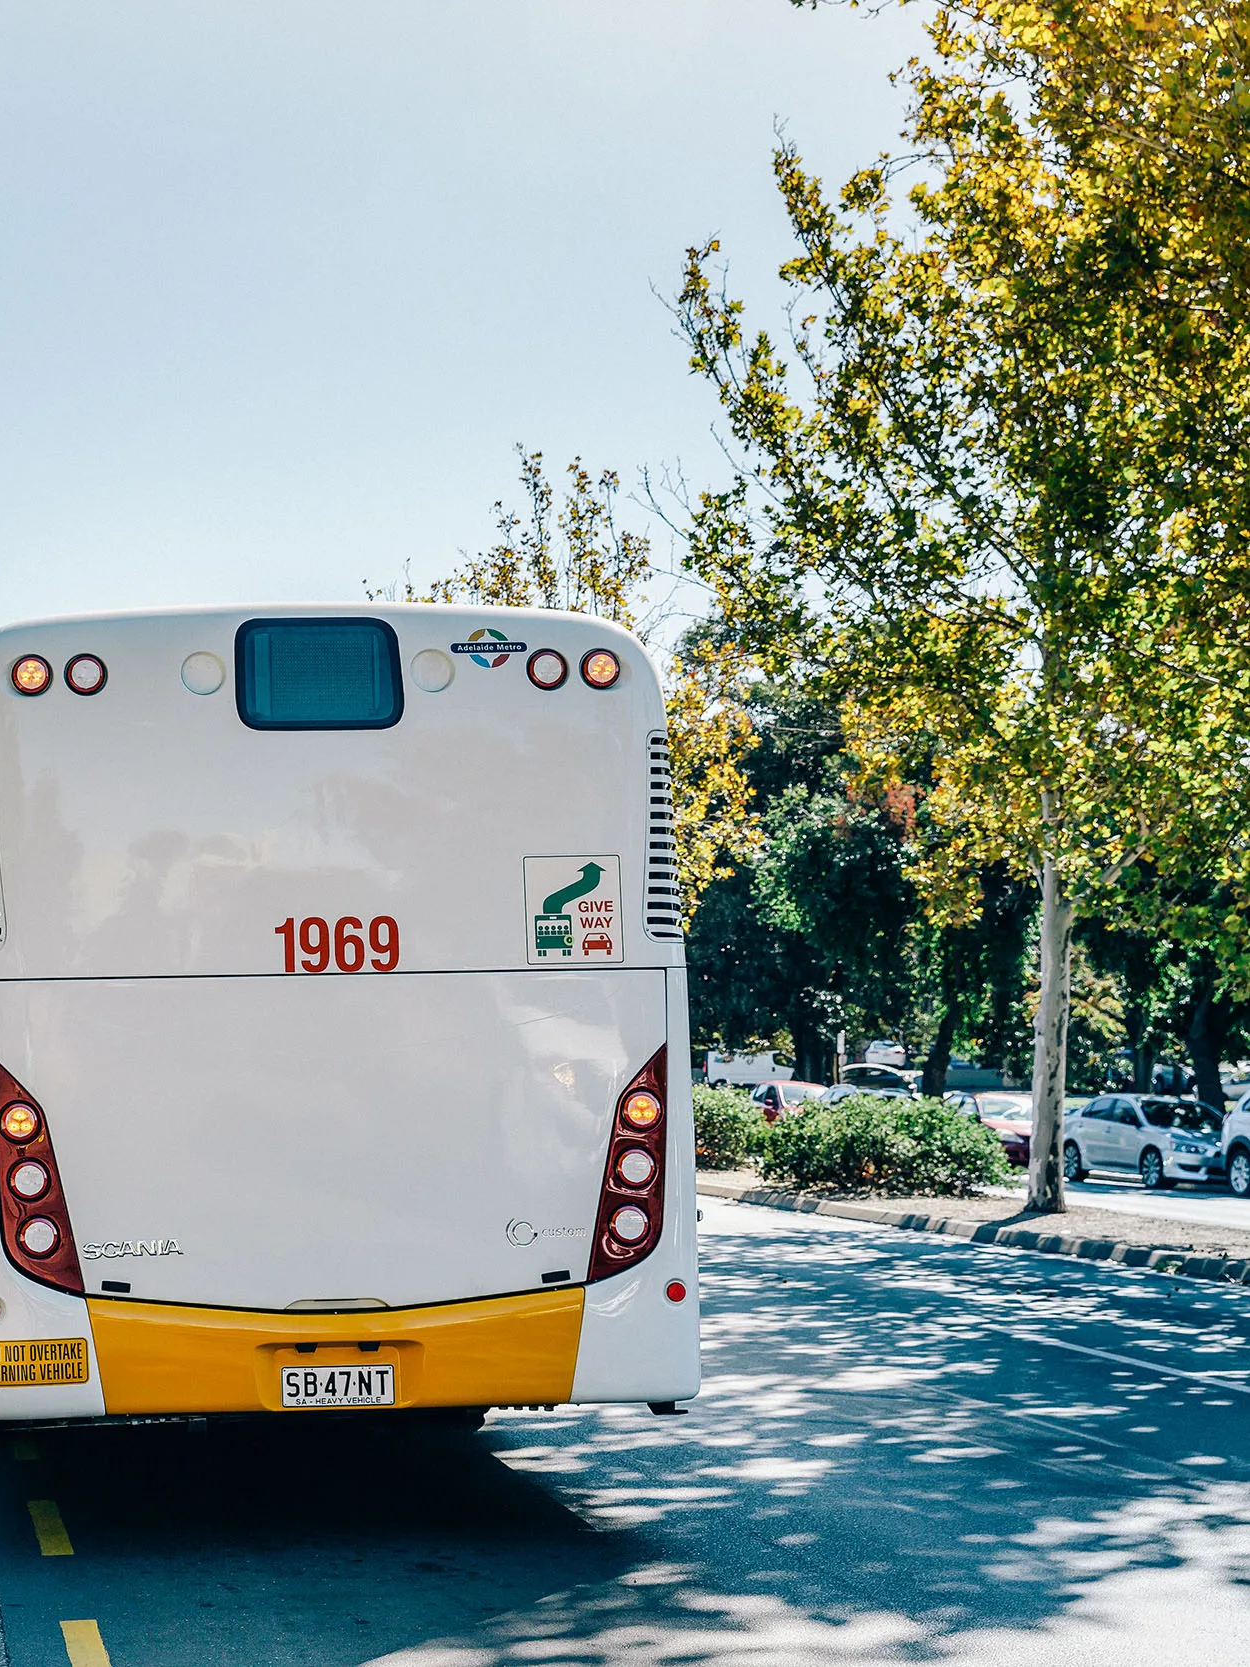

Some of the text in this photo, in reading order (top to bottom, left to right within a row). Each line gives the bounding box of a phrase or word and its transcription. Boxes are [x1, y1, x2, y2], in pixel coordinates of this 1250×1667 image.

[578, 900, 614, 913] GIVE
[580, 916, 613, 929] WAY
[274, 915, 400, 973] 1969
[541, 1227, 586, 1237] custom
[83, 1239, 184, 1260] SCANIA
[4, 1345, 26, 1362] NOT
[30, 1343, 83, 1361] OVERTAKE
[39, 1362, 83, 1380] VEHICLE
[315, 1397, 344, 1405] HEAVY
[346, 1396, 382, 1404] VEHICLE
